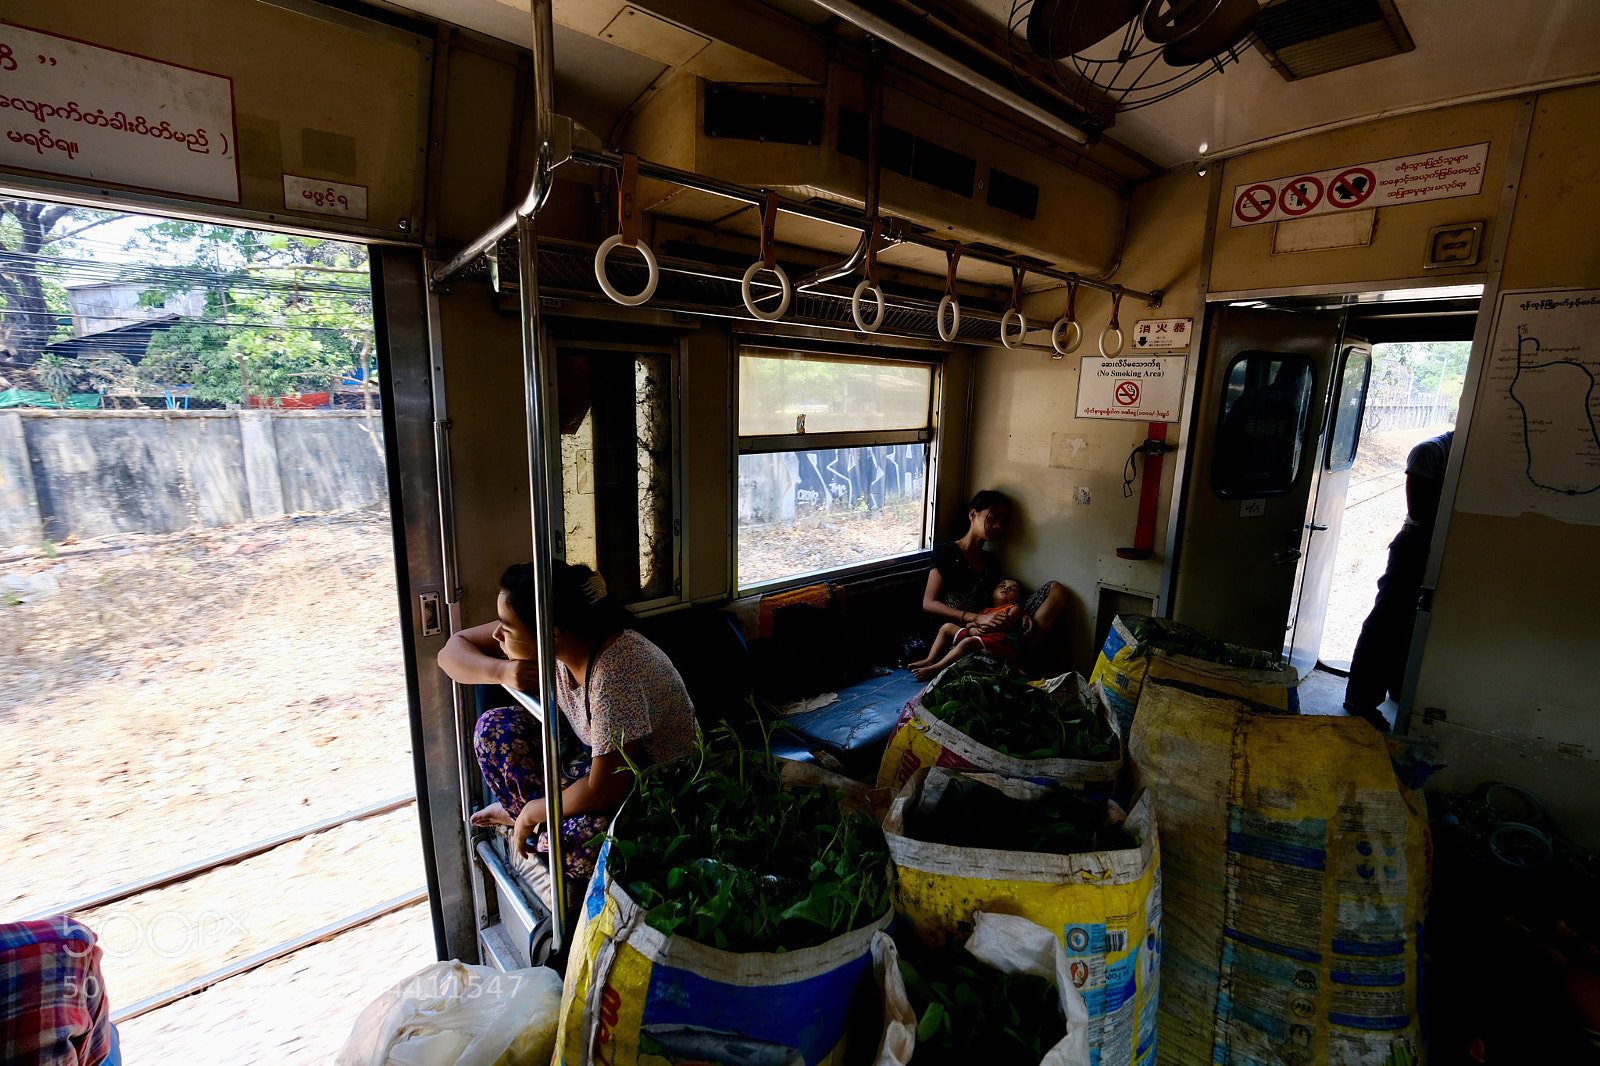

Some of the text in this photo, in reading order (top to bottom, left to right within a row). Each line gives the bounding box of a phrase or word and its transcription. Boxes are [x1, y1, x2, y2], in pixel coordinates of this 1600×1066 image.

[1139, 322, 1186, 334] 消火器
[1097, 370, 1165, 379] (No Smoking Area)
